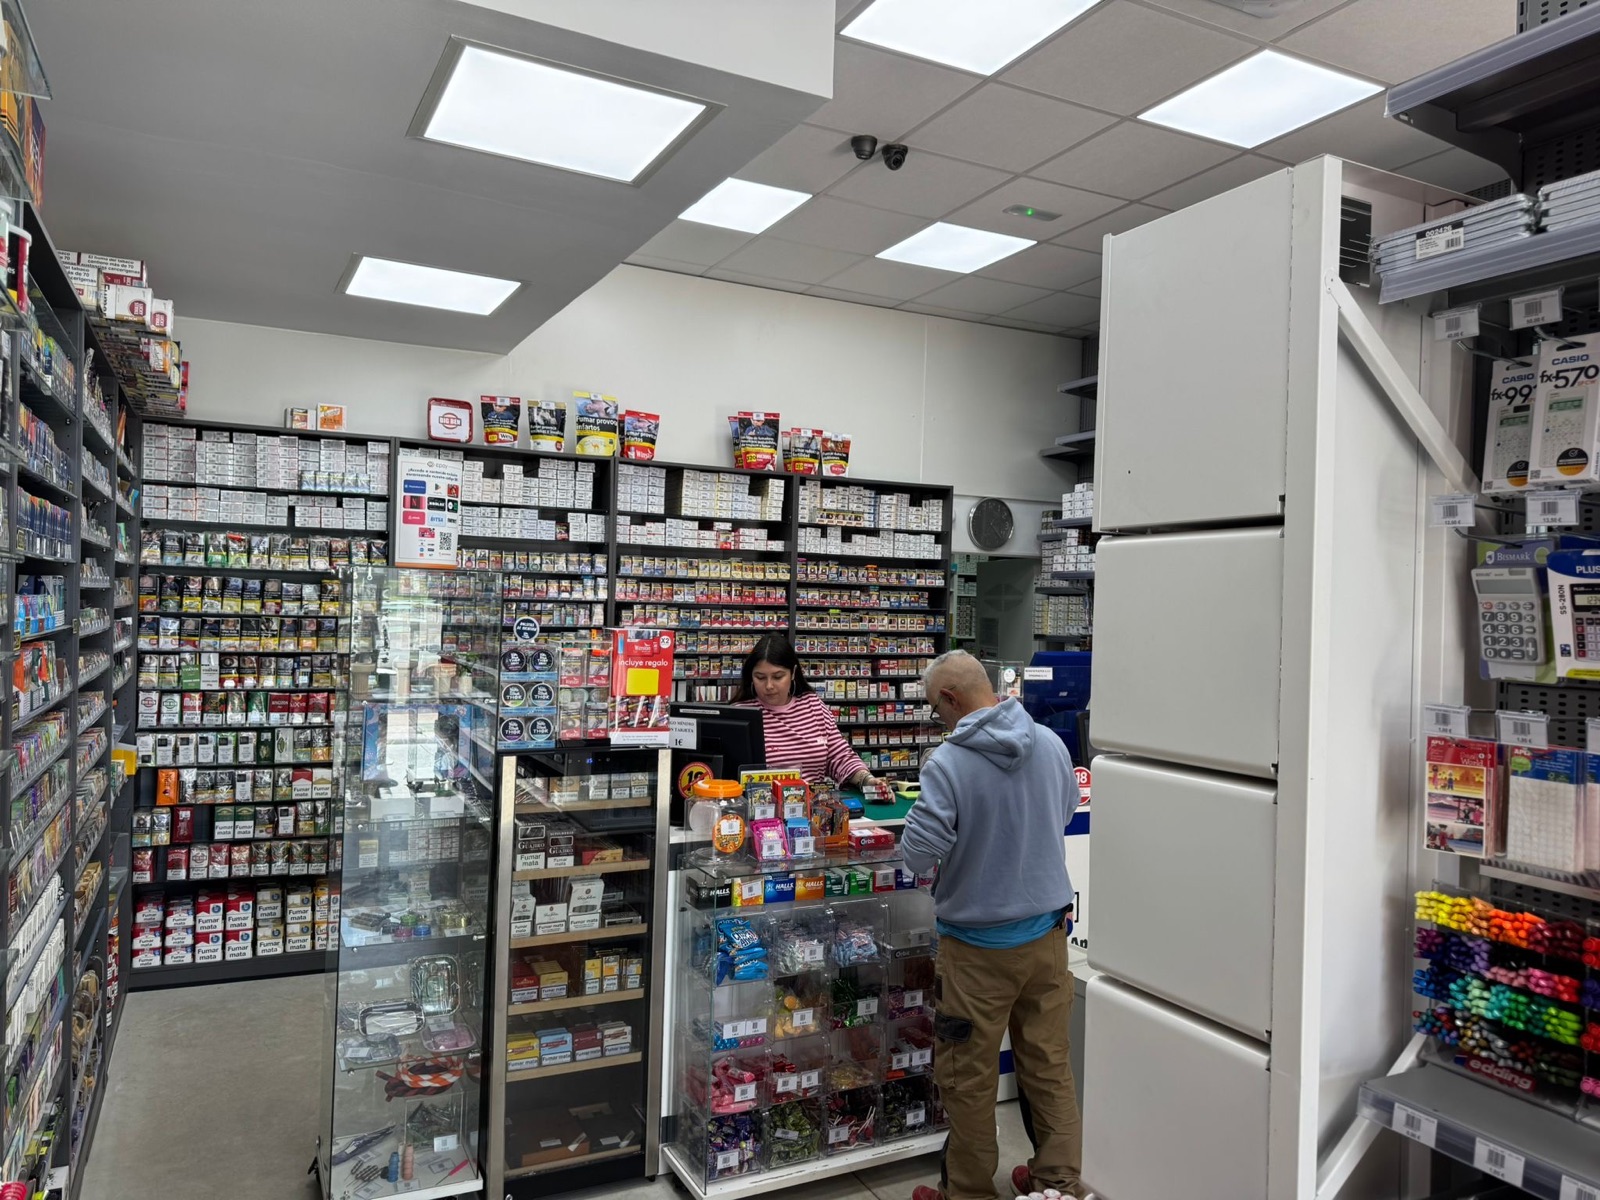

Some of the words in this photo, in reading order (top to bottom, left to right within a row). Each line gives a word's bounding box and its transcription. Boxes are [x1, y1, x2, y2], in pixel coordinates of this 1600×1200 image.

[1552, 354, 1589, 366] CASIO
[1502, 372, 1535, 384] CASIO
[1540, 364, 1599, 389] fx-570
[1576, 566, 1600, 574] PLUS
[1484, 613, 1491, 621] 7
[1497, 613, 1504, 621] 8
[1510, 613, 1517, 622] 9
[1484, 625, 1492, 633] 4
[1498, 625, 1505, 633] 5
[1511, 625, 1519, 634] 6
[1486, 637, 1491, 645] 1
[1499, 637, 1507, 645] 2
[1513, 638, 1520, 646] 3
[1487, 650, 1494, 658] 0
[618, 659, 644, 667] incluye
[645, 660, 668, 668] regalo
[1076, 772, 1088, 784] 18
[1468, 1059, 1532, 1090] edding
